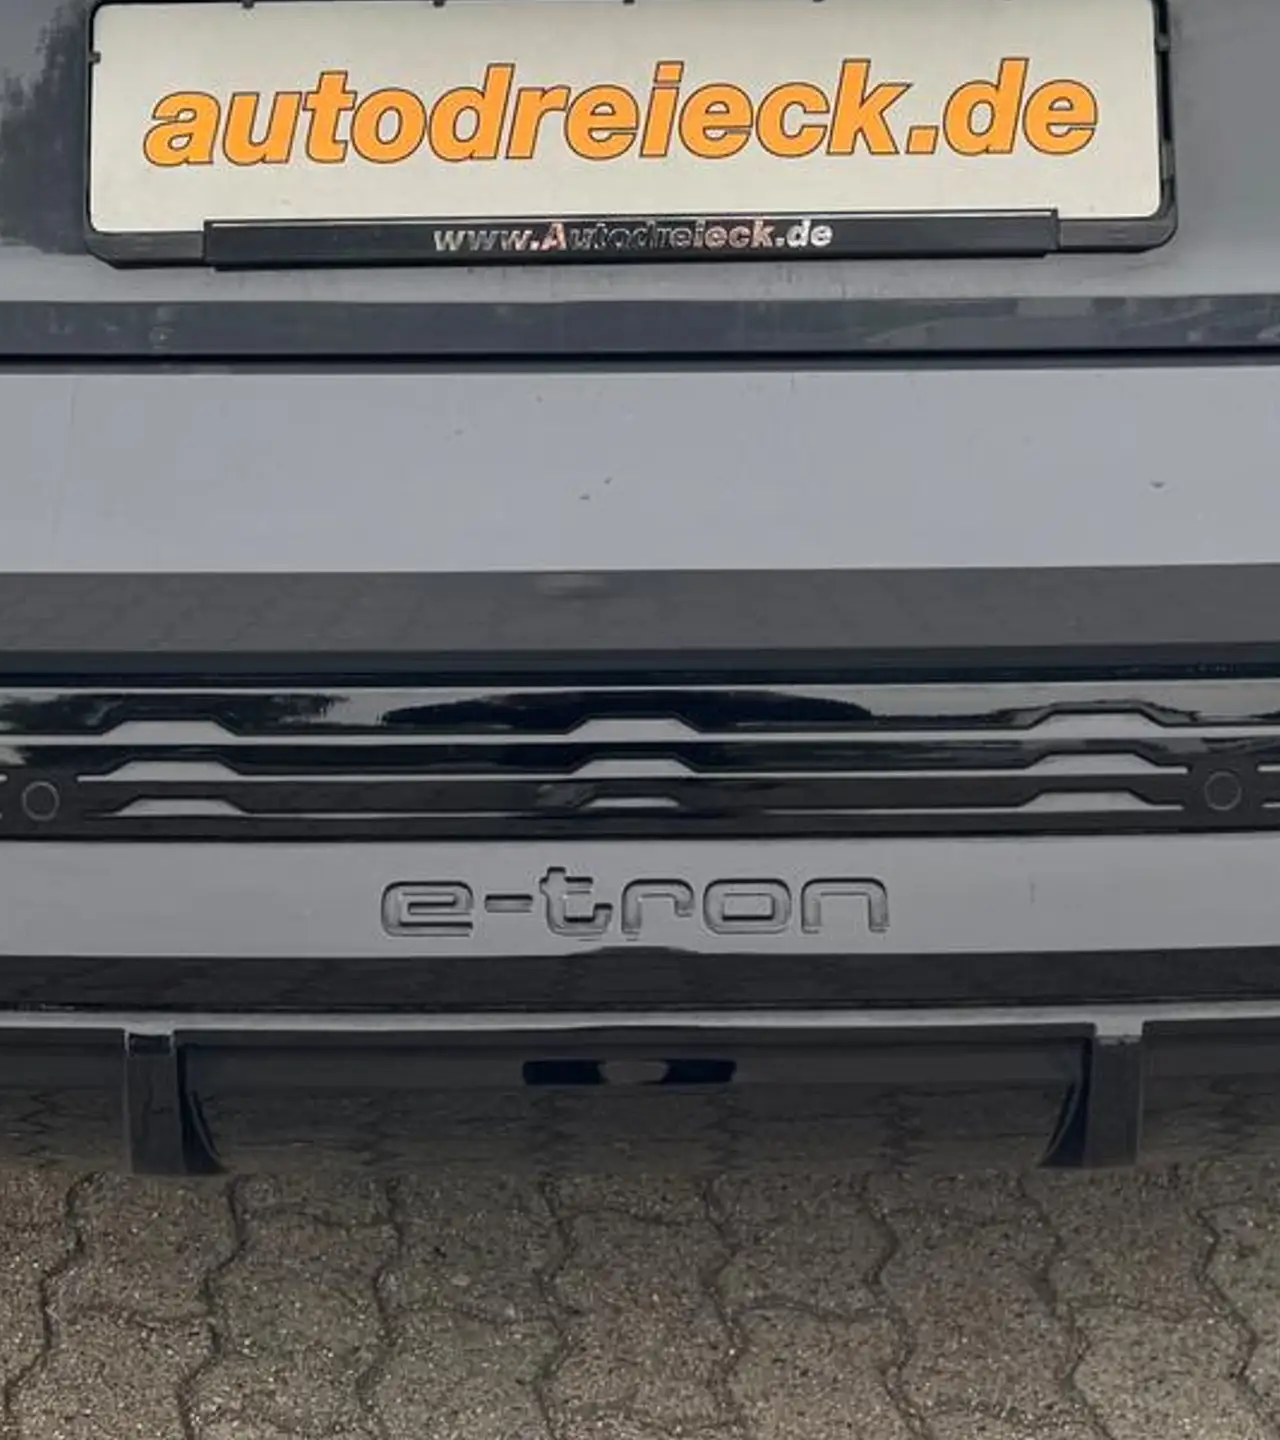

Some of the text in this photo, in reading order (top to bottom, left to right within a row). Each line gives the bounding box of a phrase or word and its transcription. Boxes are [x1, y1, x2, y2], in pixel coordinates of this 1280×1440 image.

[143, 57, 1100, 167] autodreieck.de
[432, 217, 834, 252] www.Autodreieck.de
[380, 866, 890, 940] e-tron
